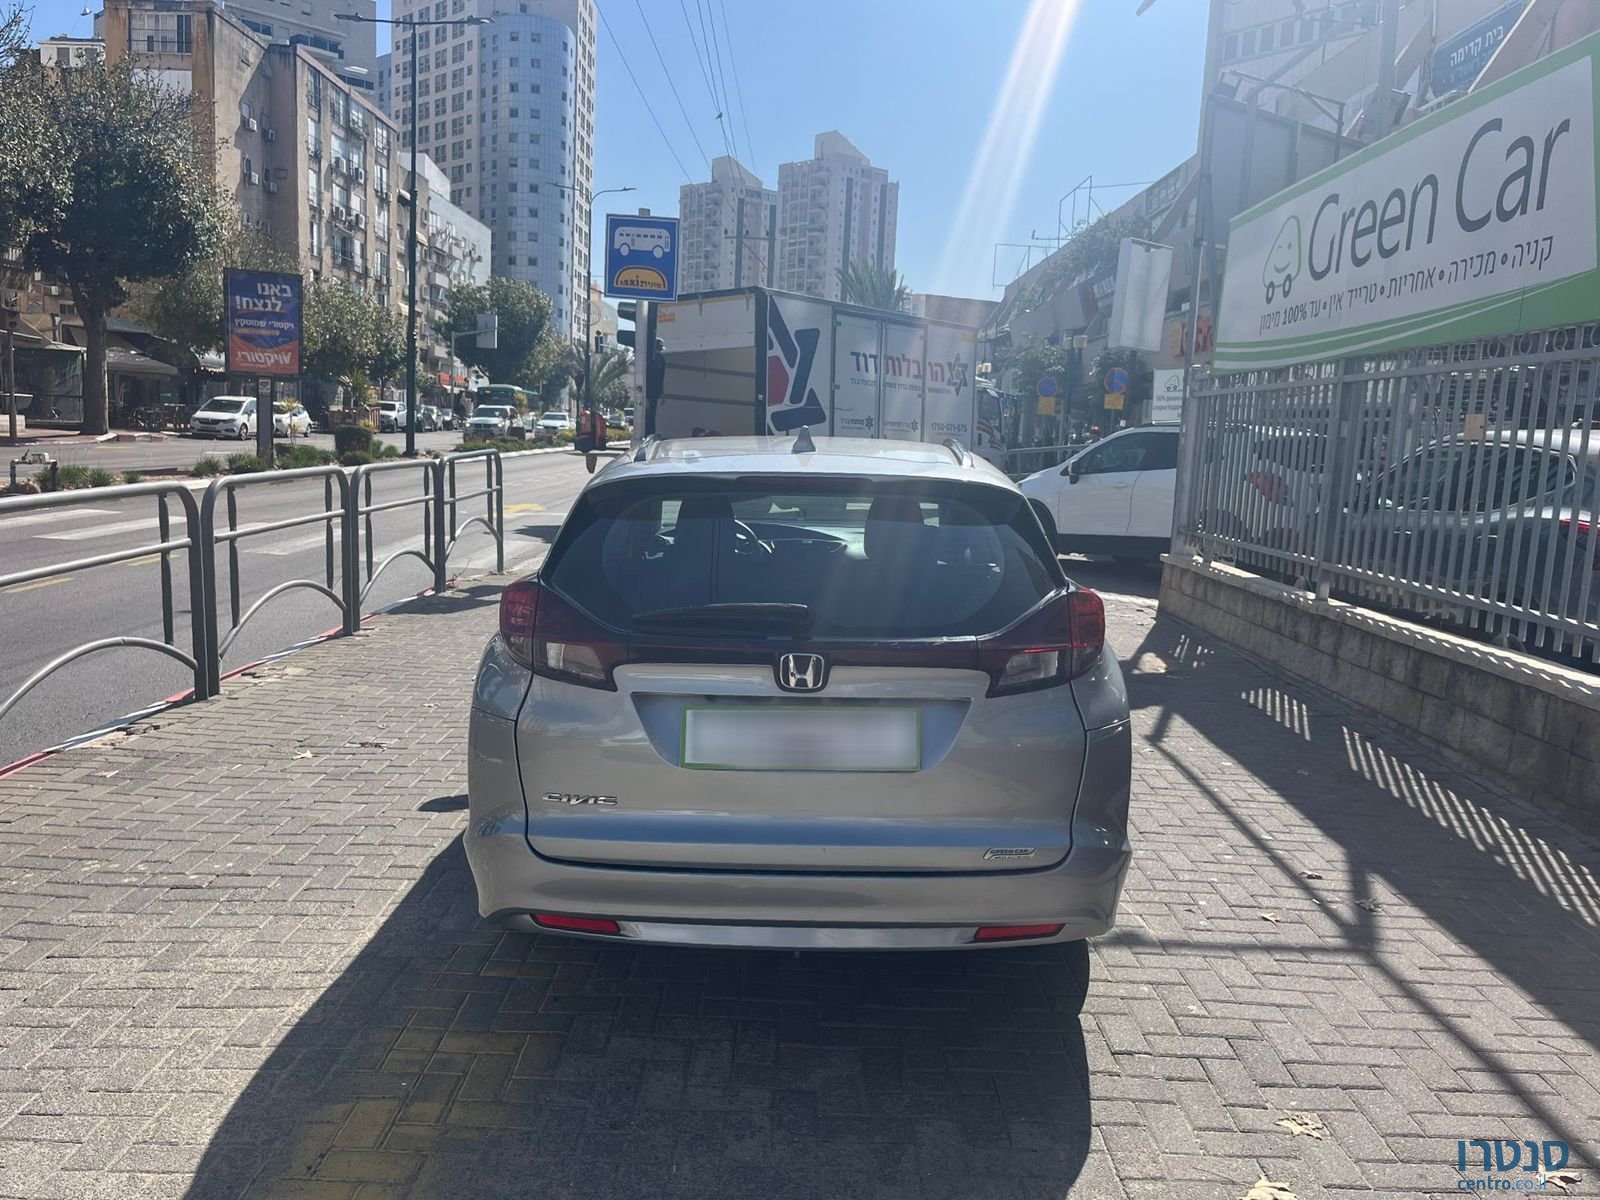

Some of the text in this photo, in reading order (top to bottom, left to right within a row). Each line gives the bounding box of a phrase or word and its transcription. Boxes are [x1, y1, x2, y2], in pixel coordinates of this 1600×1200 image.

[1450, 25, 1504, 67] בית קדימה
[1308, 117, 1571, 281] Green Car
[257, 282, 293, 297] באנו
[620, 274, 639, 287] taxi
[1259, 235, 1554, 336] קניה מכירה אחריות טרייד אין עד 100% מימון
[235, 295, 282, 312] לנצח!
[850, 351, 879, 374] דוד
[542, 792, 618, 805] CIVIC
